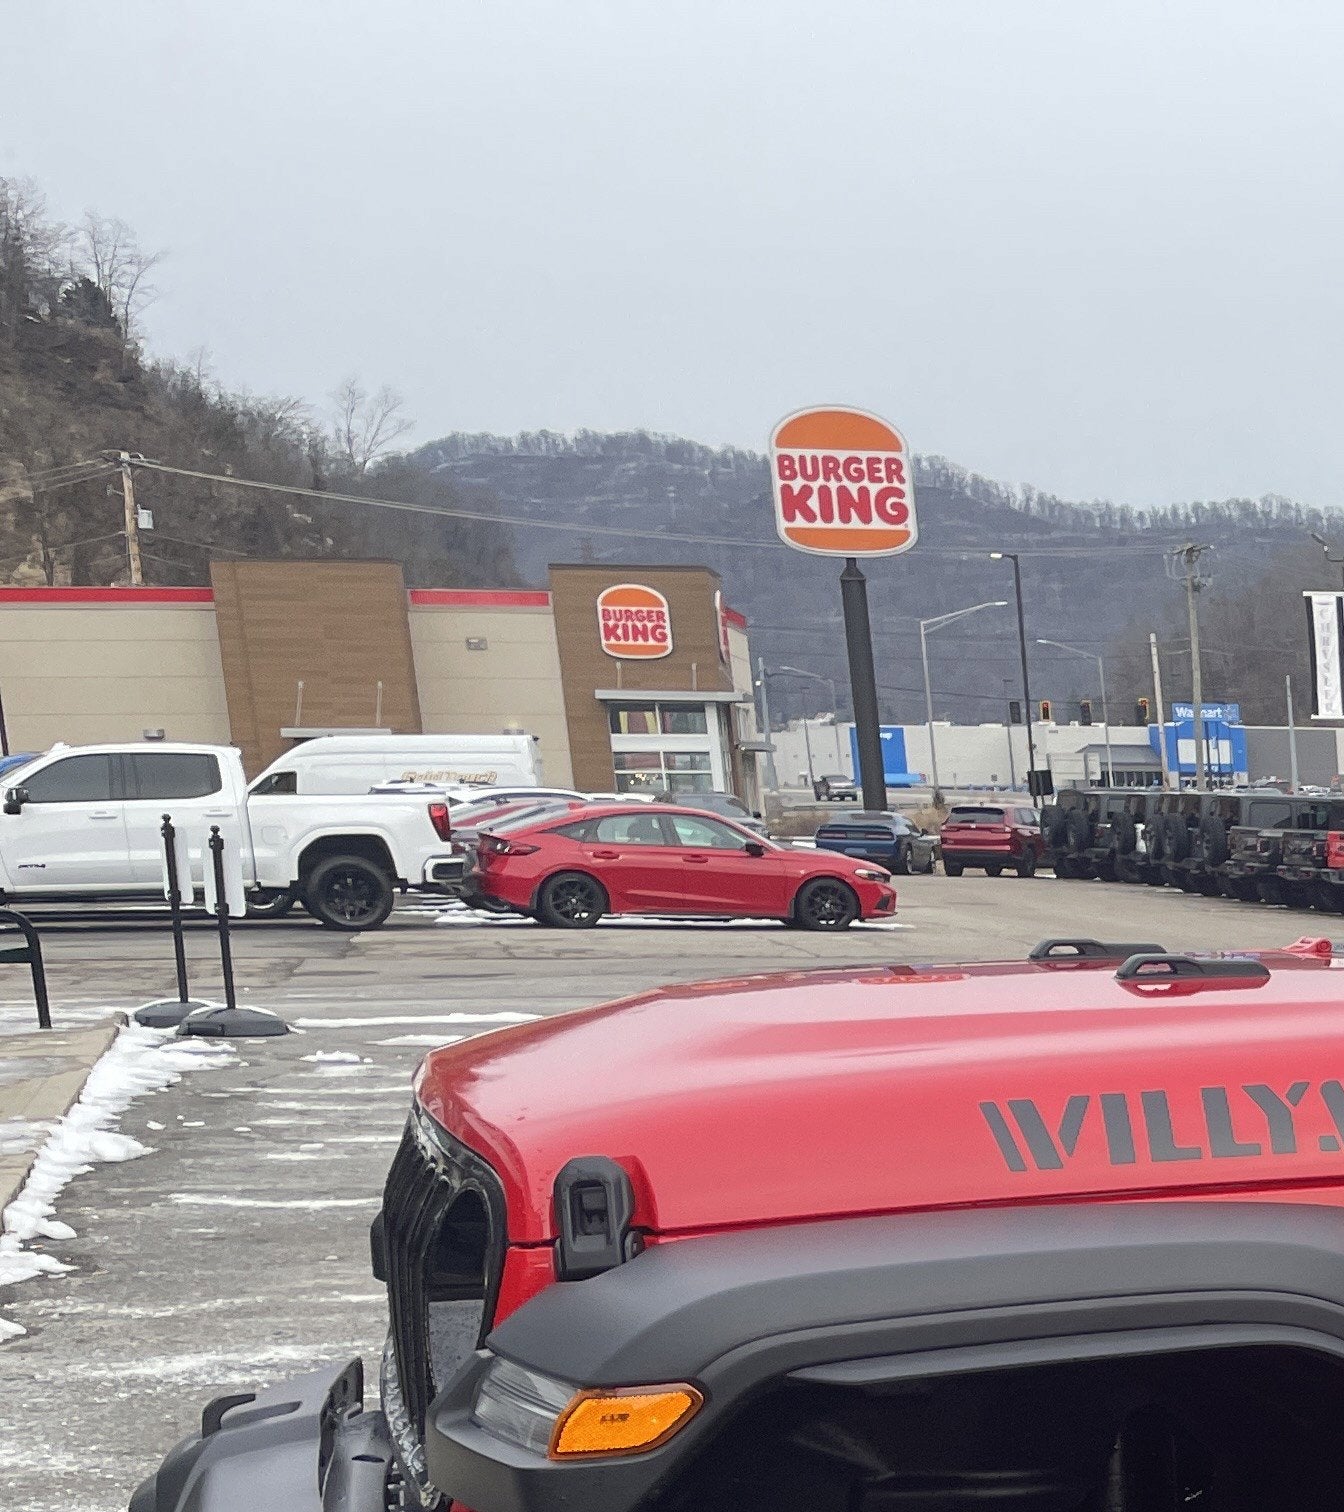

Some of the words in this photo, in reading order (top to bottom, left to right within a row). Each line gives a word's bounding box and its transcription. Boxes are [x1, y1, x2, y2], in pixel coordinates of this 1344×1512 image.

[778, 454, 905, 484] BURGER
[780, 483, 909, 526] KING
[601, 608, 666, 623] BURGER
[603, 622, 668, 643] KING
